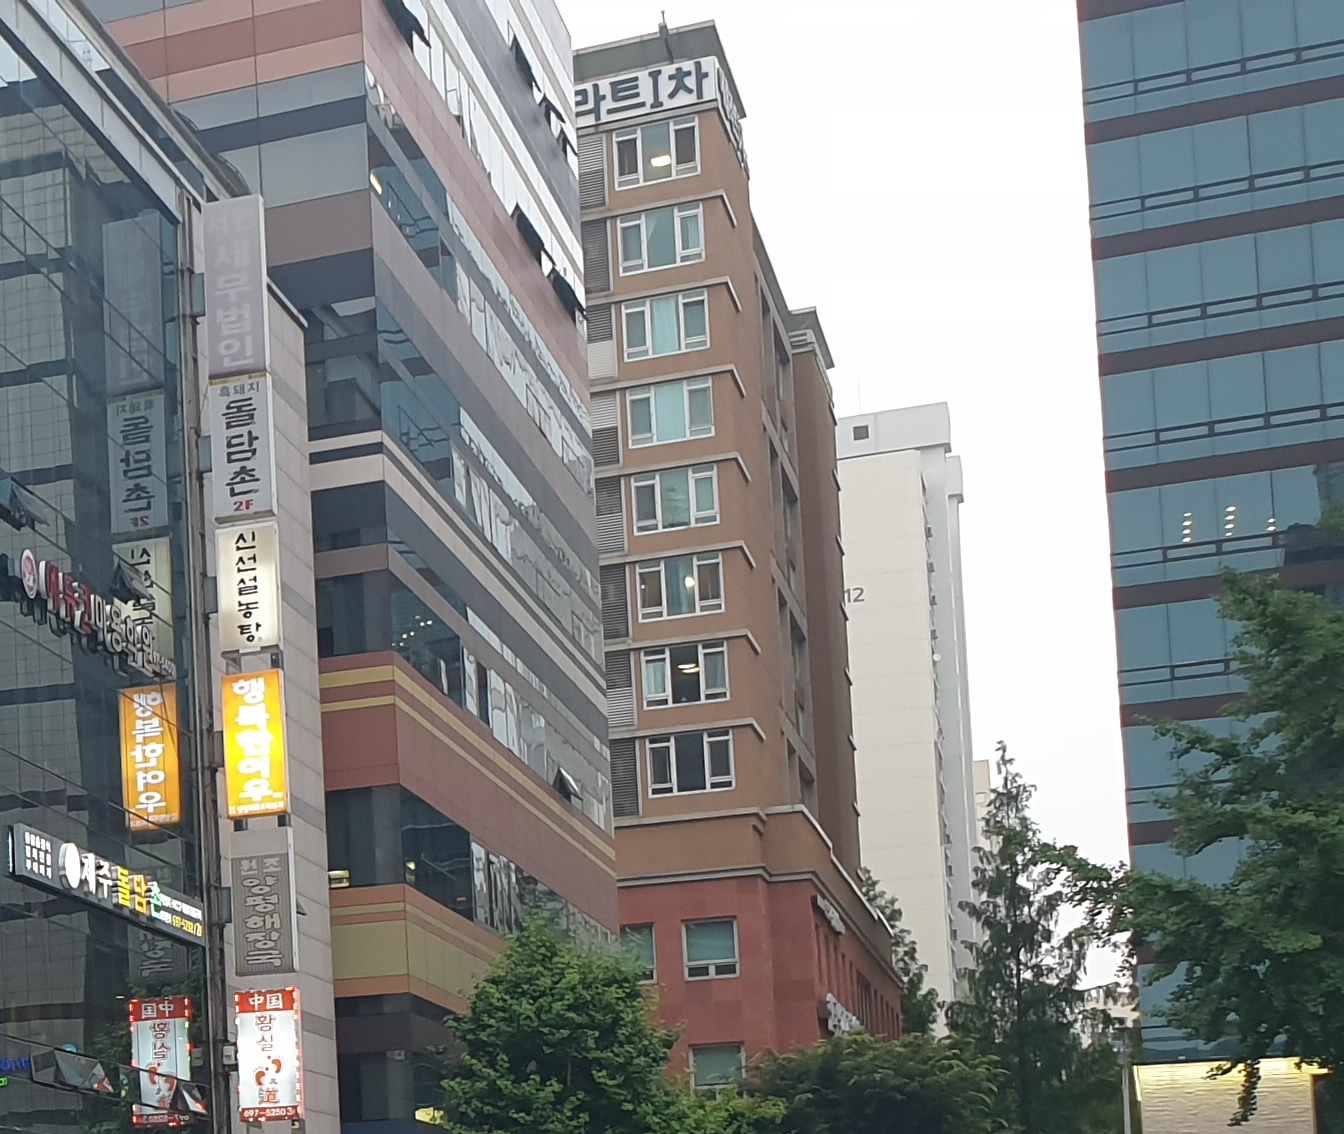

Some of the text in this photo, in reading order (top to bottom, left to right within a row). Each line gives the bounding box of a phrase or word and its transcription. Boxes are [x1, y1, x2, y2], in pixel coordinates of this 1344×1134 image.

[222, 398, 260, 498] 돌담촌
[233, 500, 253, 512] 2F
[234, 531, 262, 643] 신선설농탕
[81, 852, 112, 899] 제주
[256, 1014, 276, 1051] 황실
